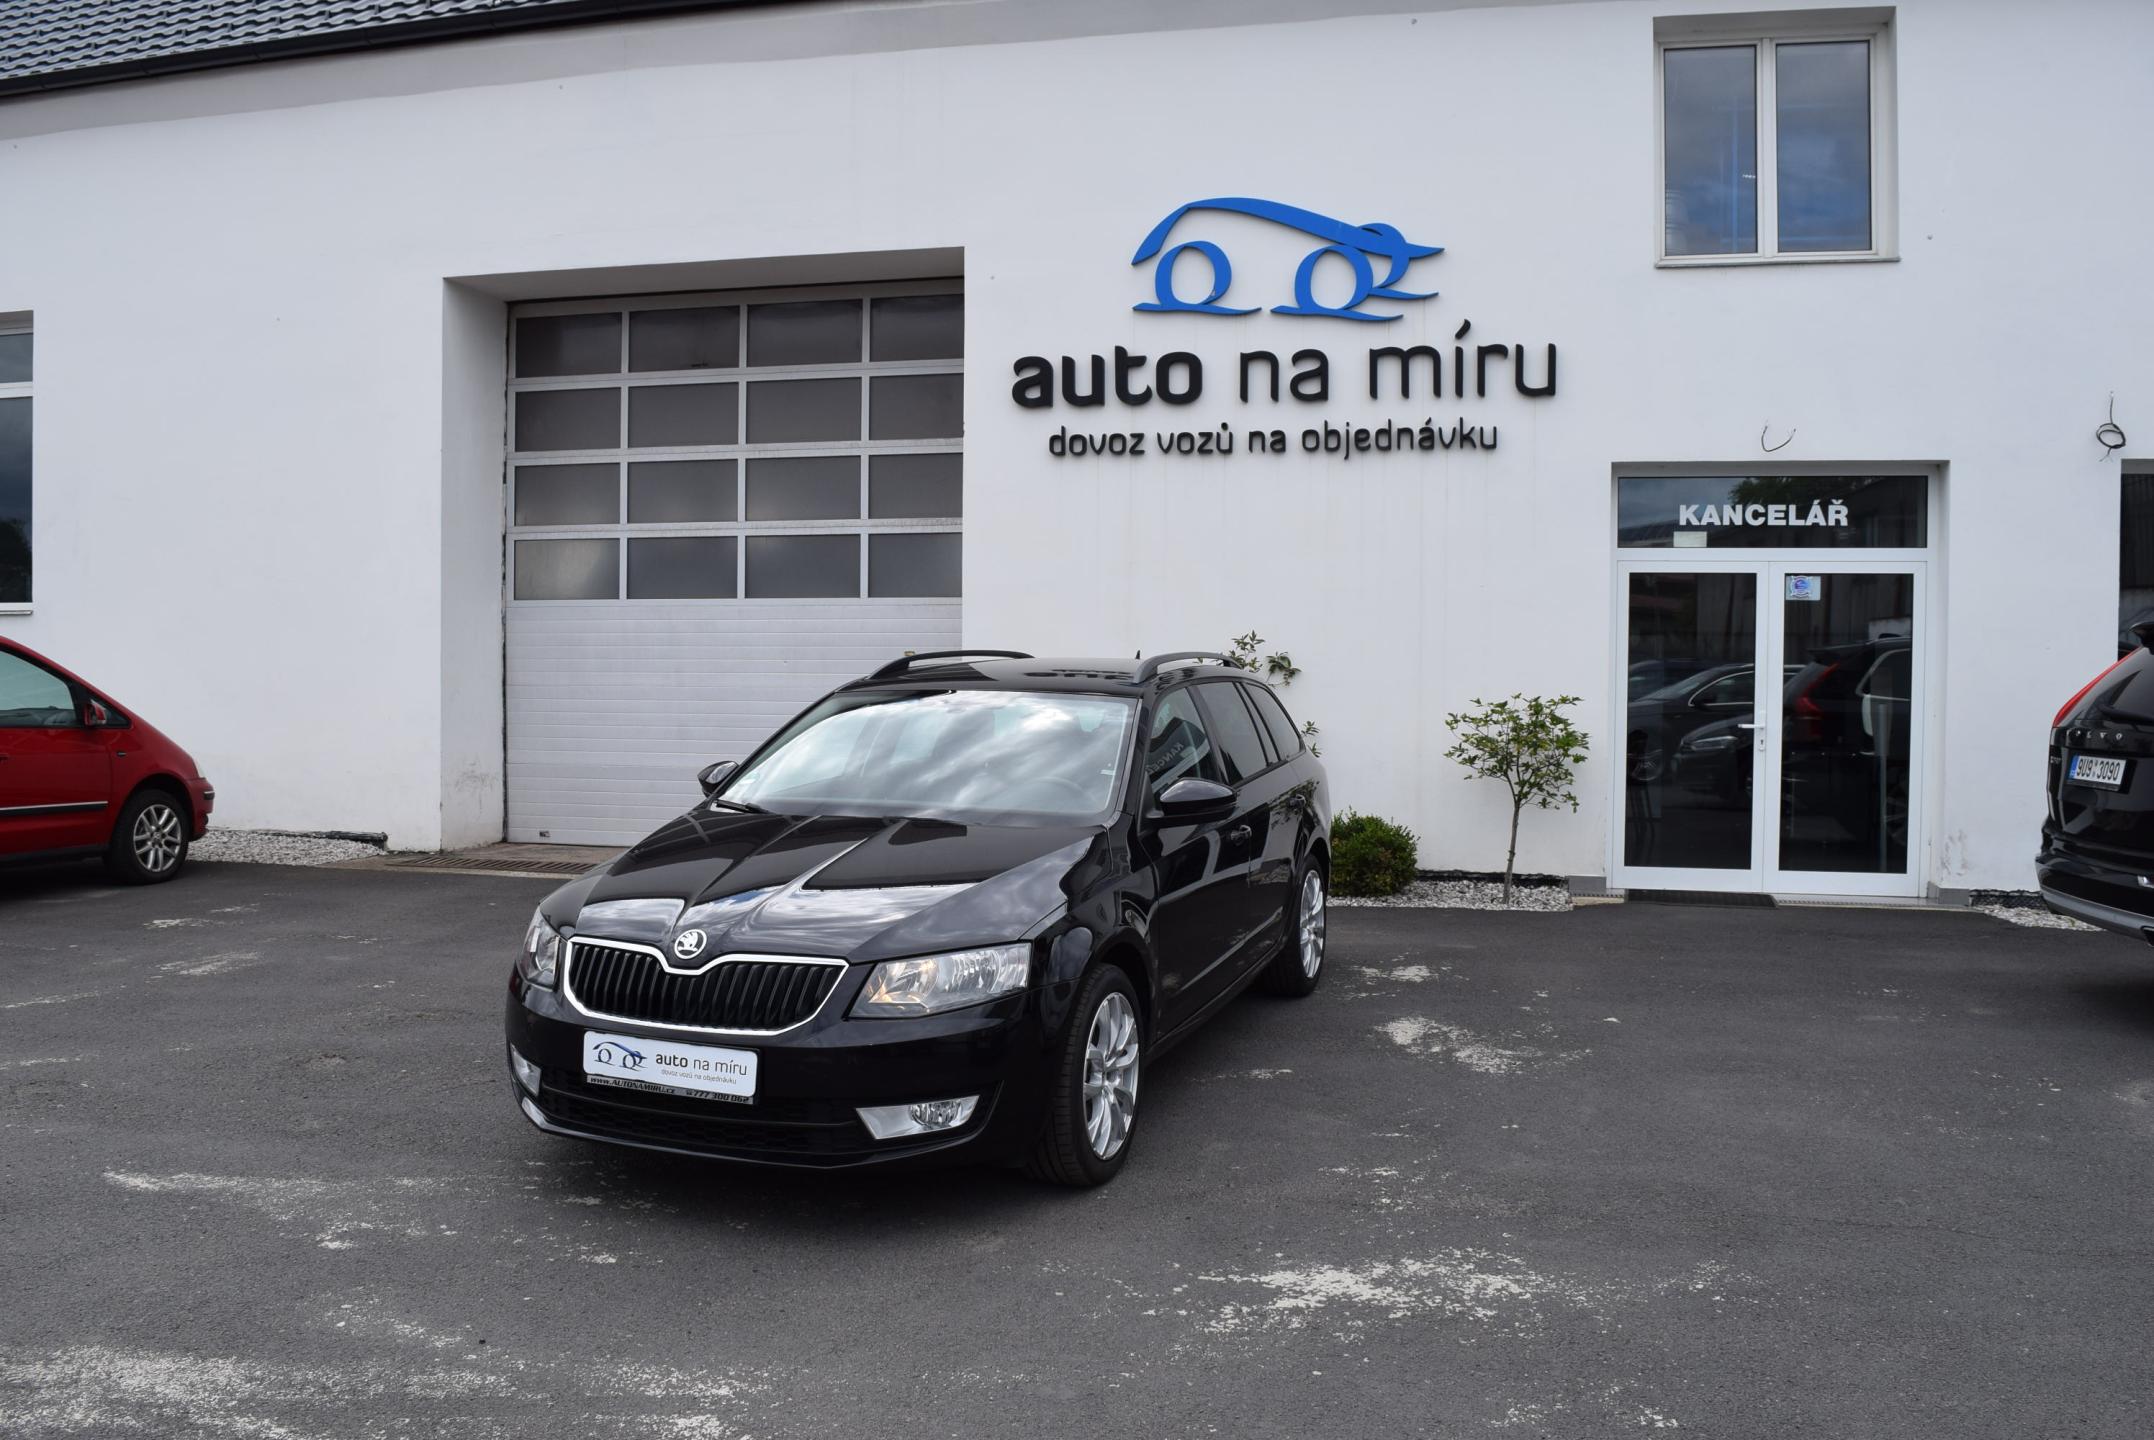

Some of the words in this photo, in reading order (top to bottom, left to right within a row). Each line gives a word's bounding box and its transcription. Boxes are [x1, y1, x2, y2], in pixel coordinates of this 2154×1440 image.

[1012, 345, 1204, 410] auto
[1239, 348, 1330, 404] na
[1369, 318, 1557, 400] míru
[1049, 426, 1145, 457] dovoz
[1157, 422, 1233, 456] vozů
[1248, 430, 1286, 455] na
[1302, 417, 1497, 460] objednávku
[1680, 499, 1849, 527] KANCELÁŘ
[2076, 758, 2094, 777] 9U9
[2096, 760, 2121, 781] 3090
[655, 1053, 688, 1068] auto
[693, 1058, 710, 1071] na
[715, 1059, 747, 1076] míru
